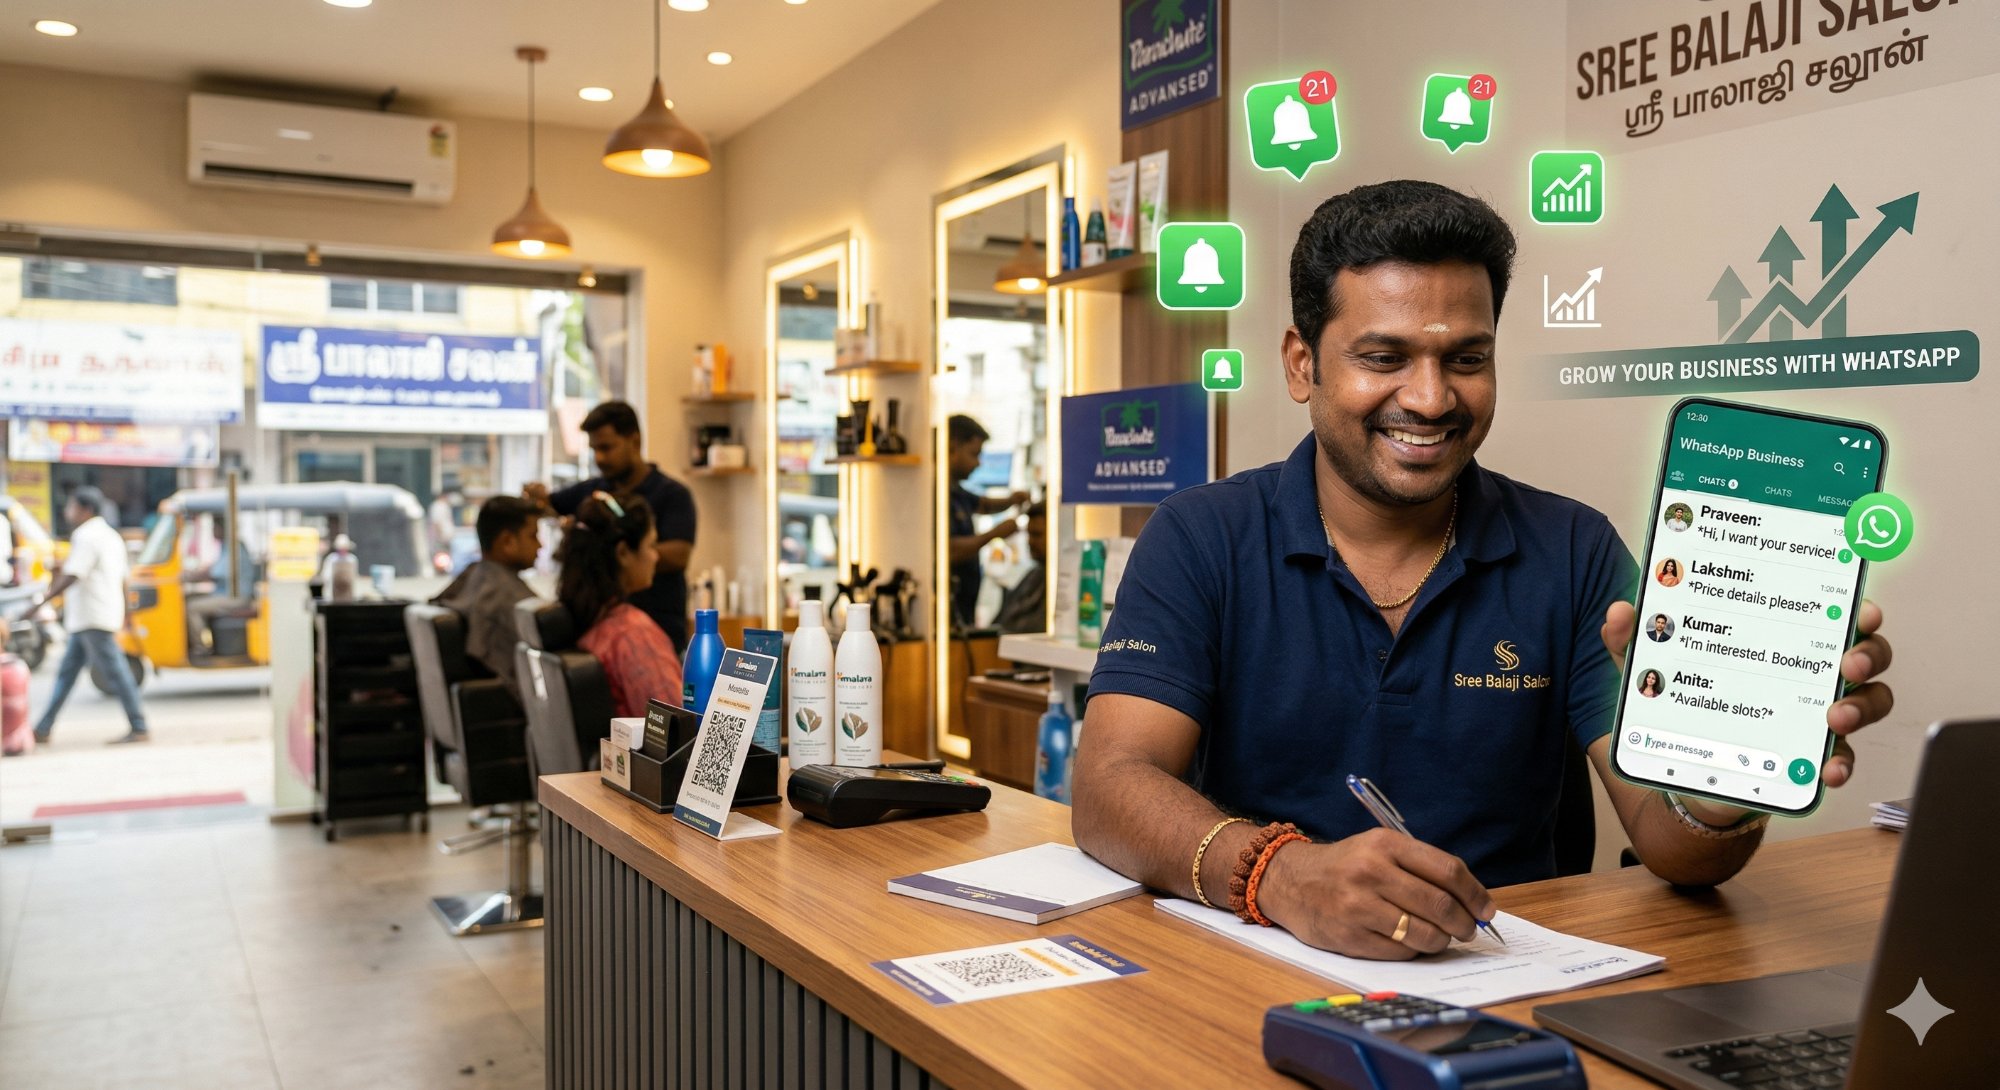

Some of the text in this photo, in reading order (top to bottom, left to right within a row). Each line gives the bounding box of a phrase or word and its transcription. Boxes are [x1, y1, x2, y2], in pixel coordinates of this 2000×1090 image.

[1577, 32, 1658, 100] SREE
[1671, 0, 1801, 77] BALAJI
[1673, 59, 1794, 119] பாலாஜி
[1805, 27, 1929, 93] சலூன்
[1680, 437, 1805, 468] WhatsApp Business
[1095, 459, 1167, 477] ADVANSED
[1698, 475, 1726, 487] CHATS
[1764, 486, 1792, 498] CHATS
[1700, 505, 1762, 527] Praveen:
[1833, 528, 1845, 538] 1:2
[1721, 529, 1726, 541] I
[1728, 534, 1758, 546] want
[1759, 538, 1787, 551] your
[1789, 542, 1836, 560] service!
[1691, 560, 1754, 583] Lakshmi:
[1727, 587, 1767, 605] details
[1835, 587, 1848, 596] AM
[1682, 615, 1733, 636] Kumar:
[1126, 639, 1156, 653] Salon
[1705, 640, 1768, 663] interested.
[1455, 673, 1482, 687] Sree
[1486, 674, 1520, 692] Balaji
[1672, 671, 1714, 690] Anita:
[1812, 698, 1825, 707] AM
[1648, 738, 1667, 749] Type
[1675, 744, 1714, 759] message
